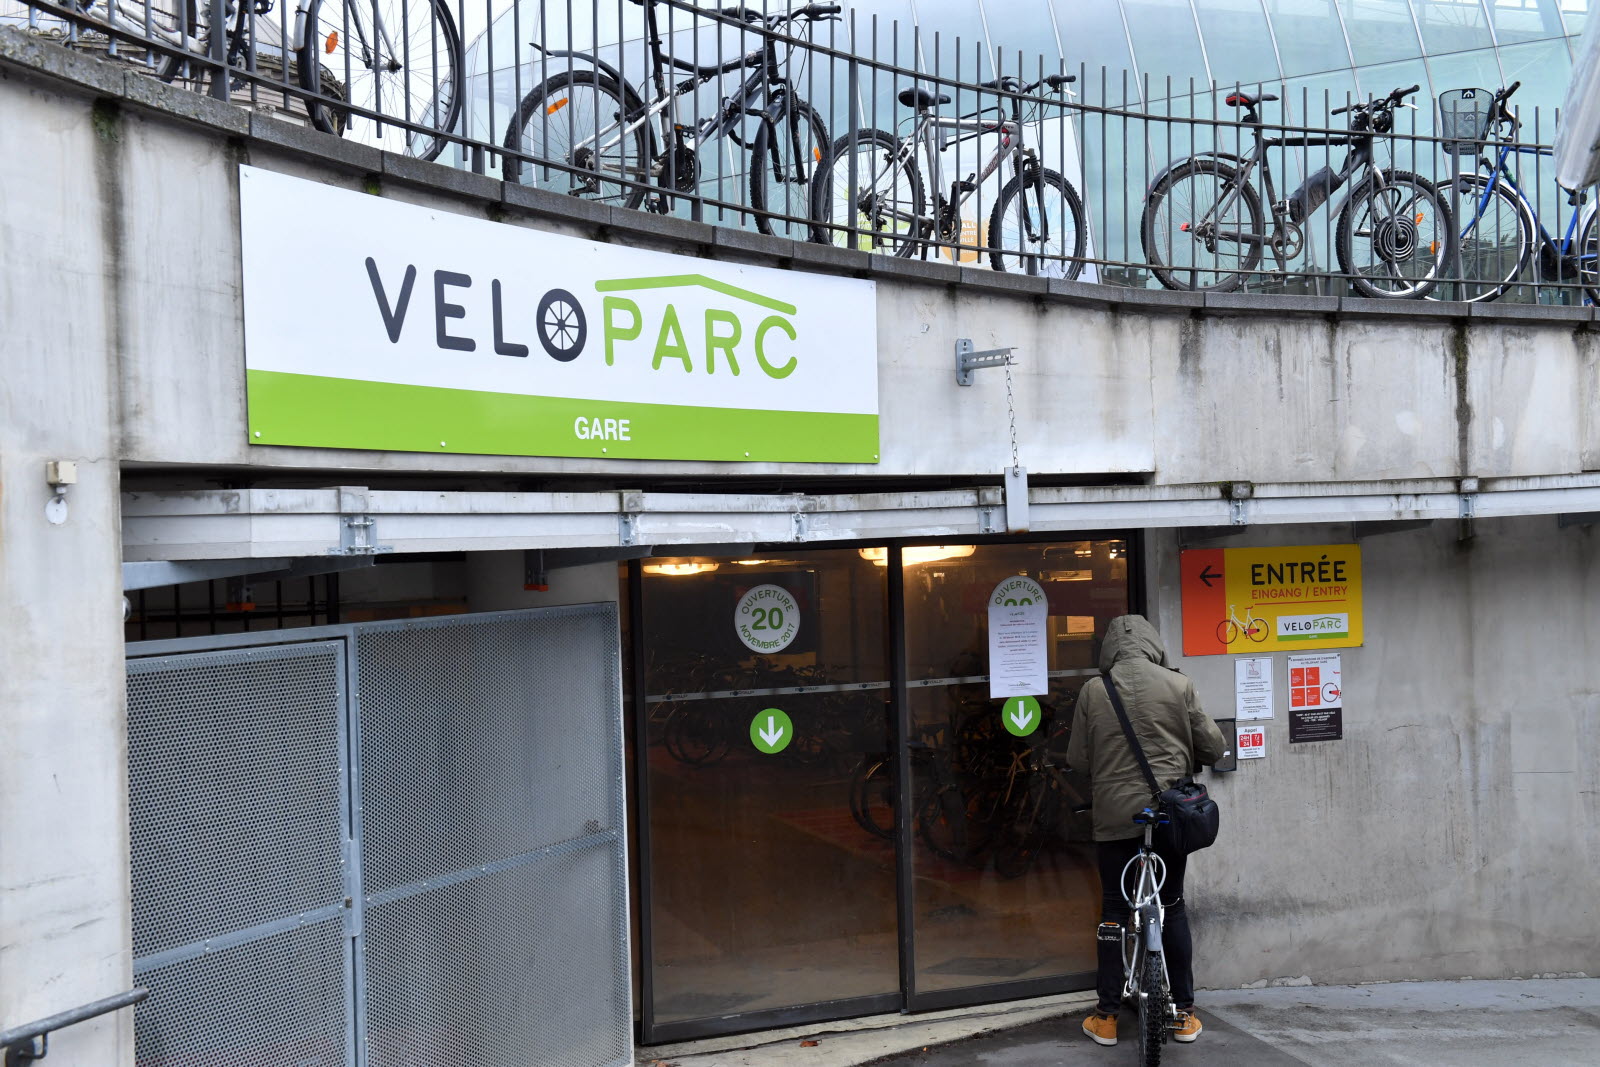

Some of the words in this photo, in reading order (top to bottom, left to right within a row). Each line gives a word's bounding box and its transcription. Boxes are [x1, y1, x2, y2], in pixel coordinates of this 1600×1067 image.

[365, 256, 797, 379] VELOPARC
[574, 416, 631, 442] GARE
[1251, 555, 1347, 585] ENTRÉE
[741, 589, 794, 615] OUVERTURE
[994, 580, 1042, 605] OUVERTURE
[1251, 587, 1302, 599] EINGANG
[1305, 586, 1310, 598] /
[1313, 585, 1348, 597] ENTRY
[751, 607, 783, 630] 20
[1284, 619, 1341, 631] VELOPARC
[740, 624, 780, 649] NOVEMBRE
[781, 623, 795, 642] 2017
